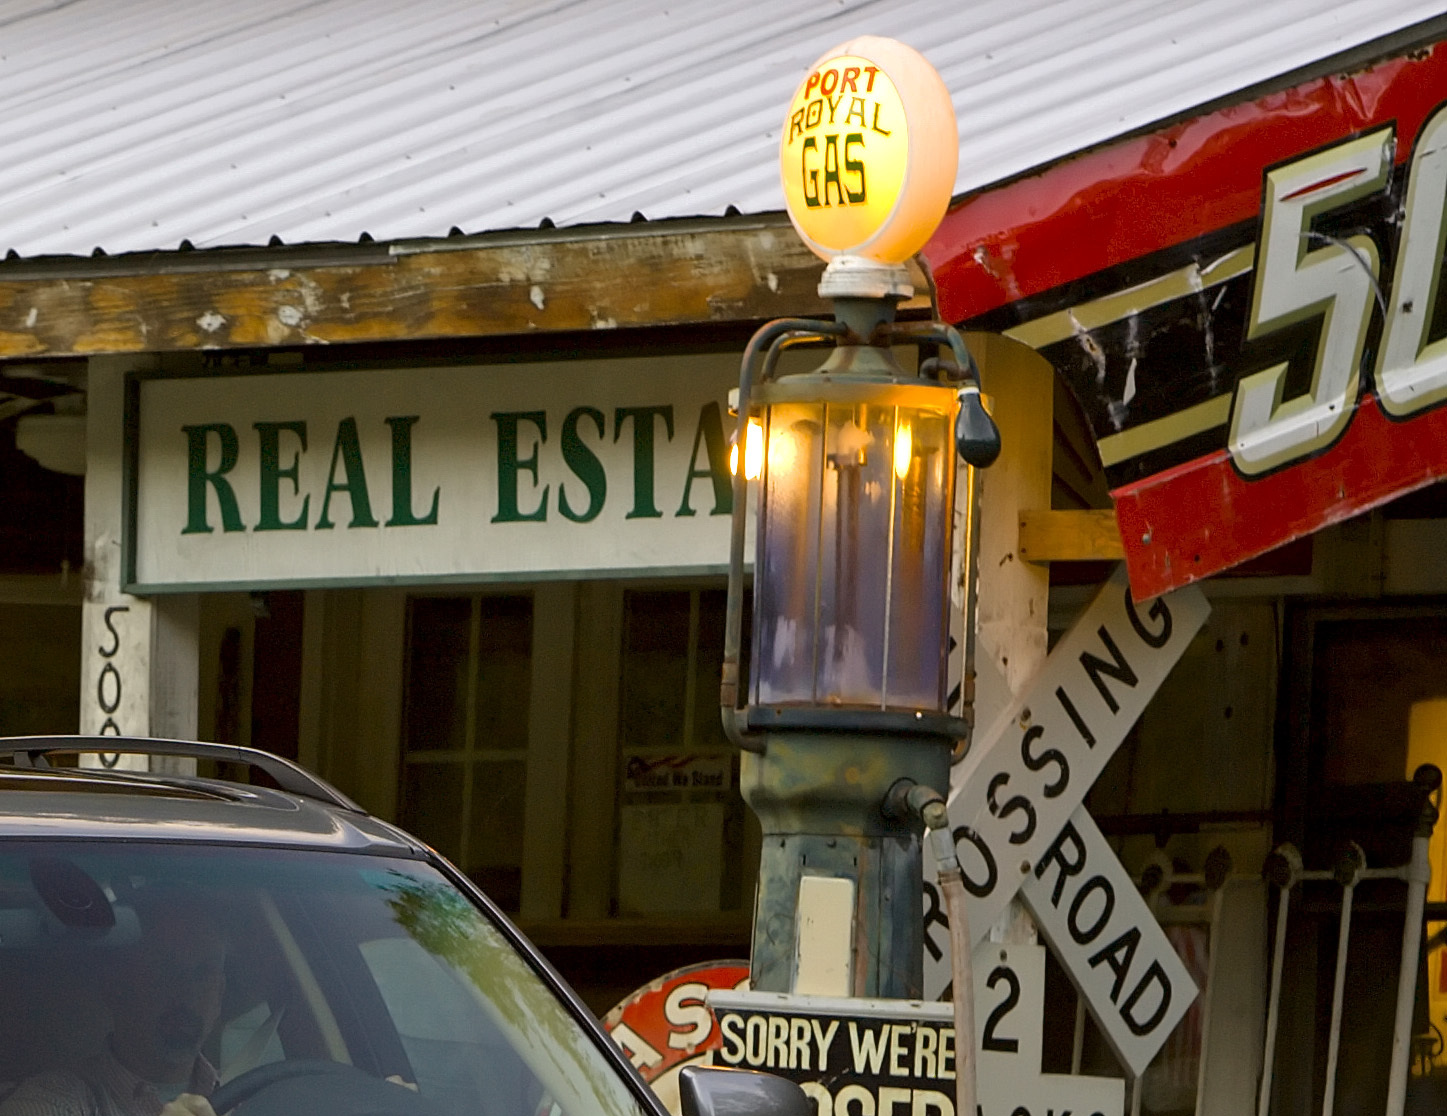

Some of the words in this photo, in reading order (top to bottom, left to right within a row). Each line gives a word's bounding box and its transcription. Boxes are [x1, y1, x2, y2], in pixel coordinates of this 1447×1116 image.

[788, 95, 891, 146] ROYAL
[804, 66, 880, 99] PORT
[802, 132, 867, 209] GAS
[180, 414, 441, 535] REAL
[489, 401, 733, 525] ESTA
[98, 606, 130, 769] 500
[923, 587, 1174, 963] ROSSING
[1034, 820, 1173, 1037] ROAD
[720, 1012, 840, 1073] SORRY
[848, 1019, 957, 1080] WE'RE
[981, 965, 1021, 1054] 2
